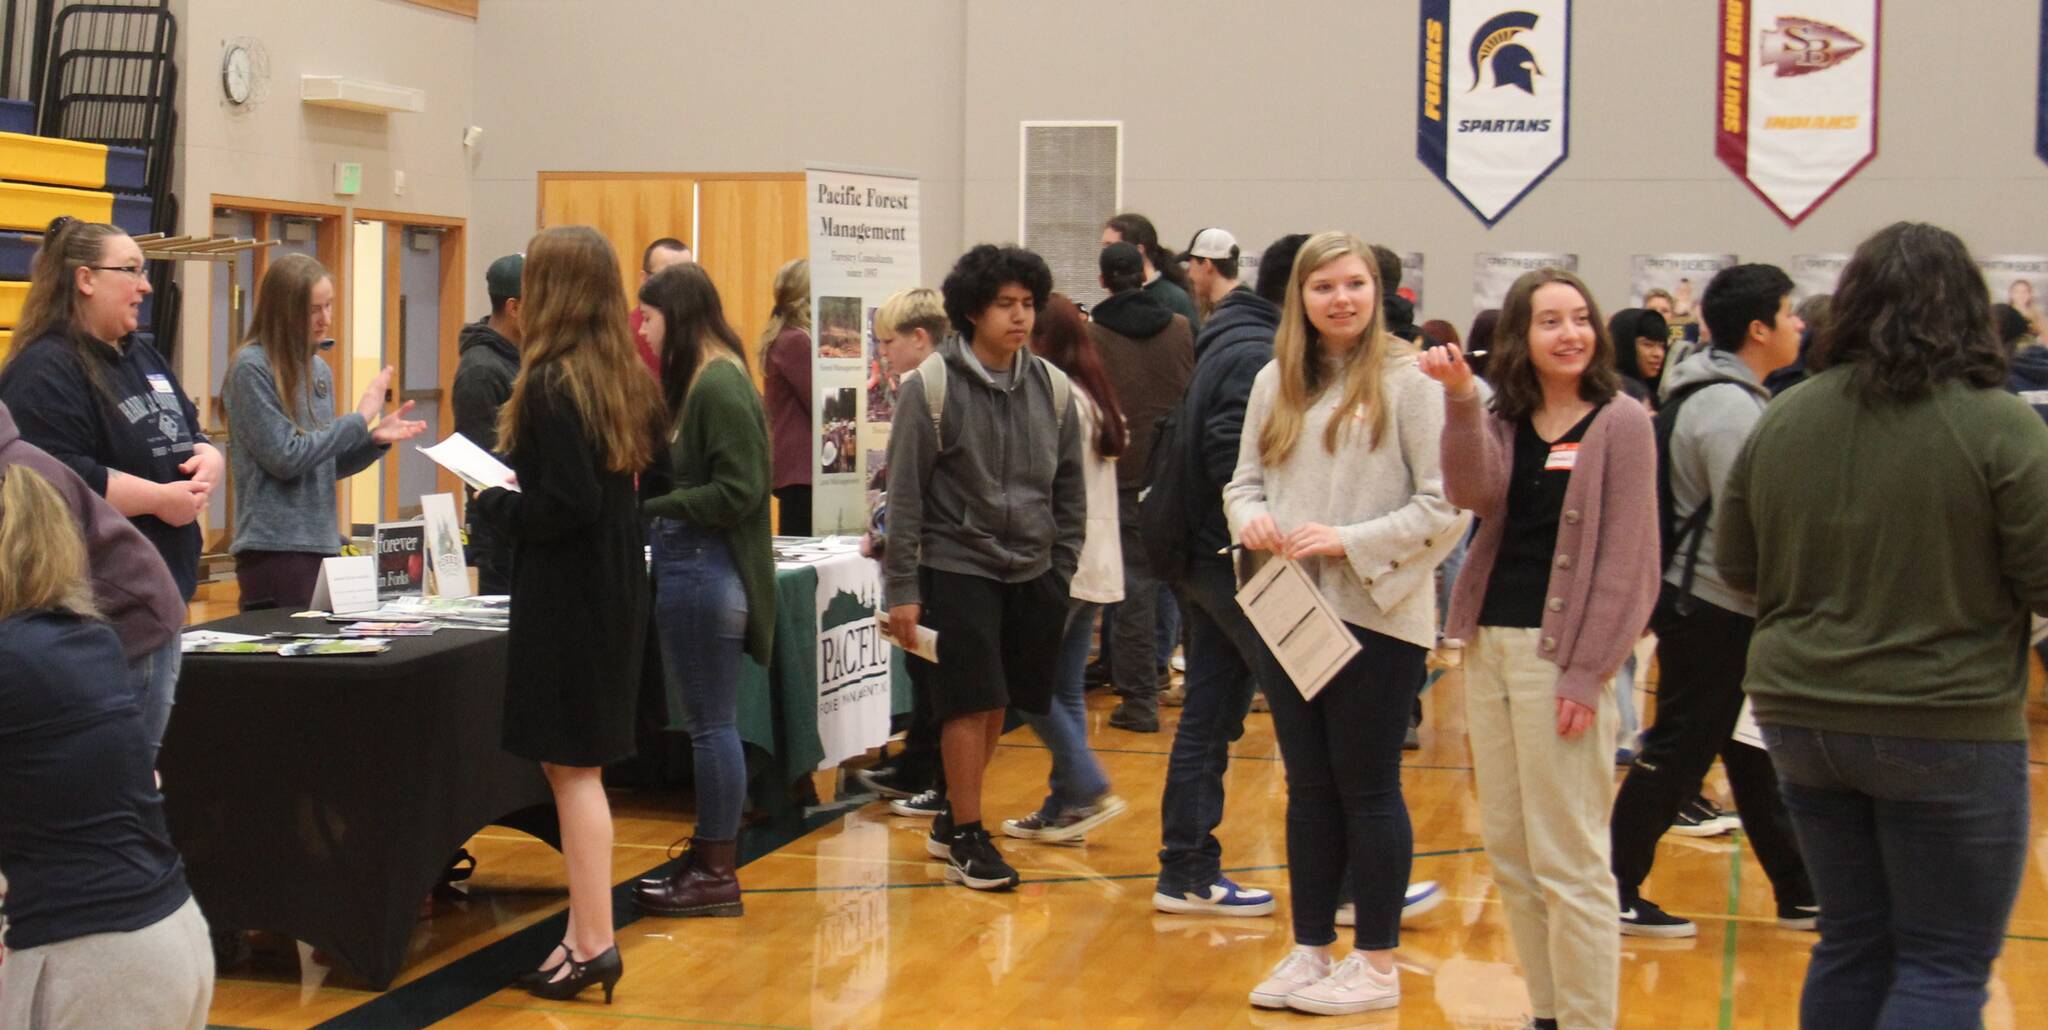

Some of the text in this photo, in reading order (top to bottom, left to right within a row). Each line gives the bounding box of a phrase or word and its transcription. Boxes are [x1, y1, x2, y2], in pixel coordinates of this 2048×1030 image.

[1424, 18, 1443, 121] FORKS
[1723, 60, 1743, 133] SOUTH
[1457, 119, 1551, 133] SPARTANS
[1763, 115, 1858, 129] INDIANS
[818, 183, 908, 210] Pacific Forest
[820, 217, 905, 243] Management
[821, 624, 887, 684] PACFIC
